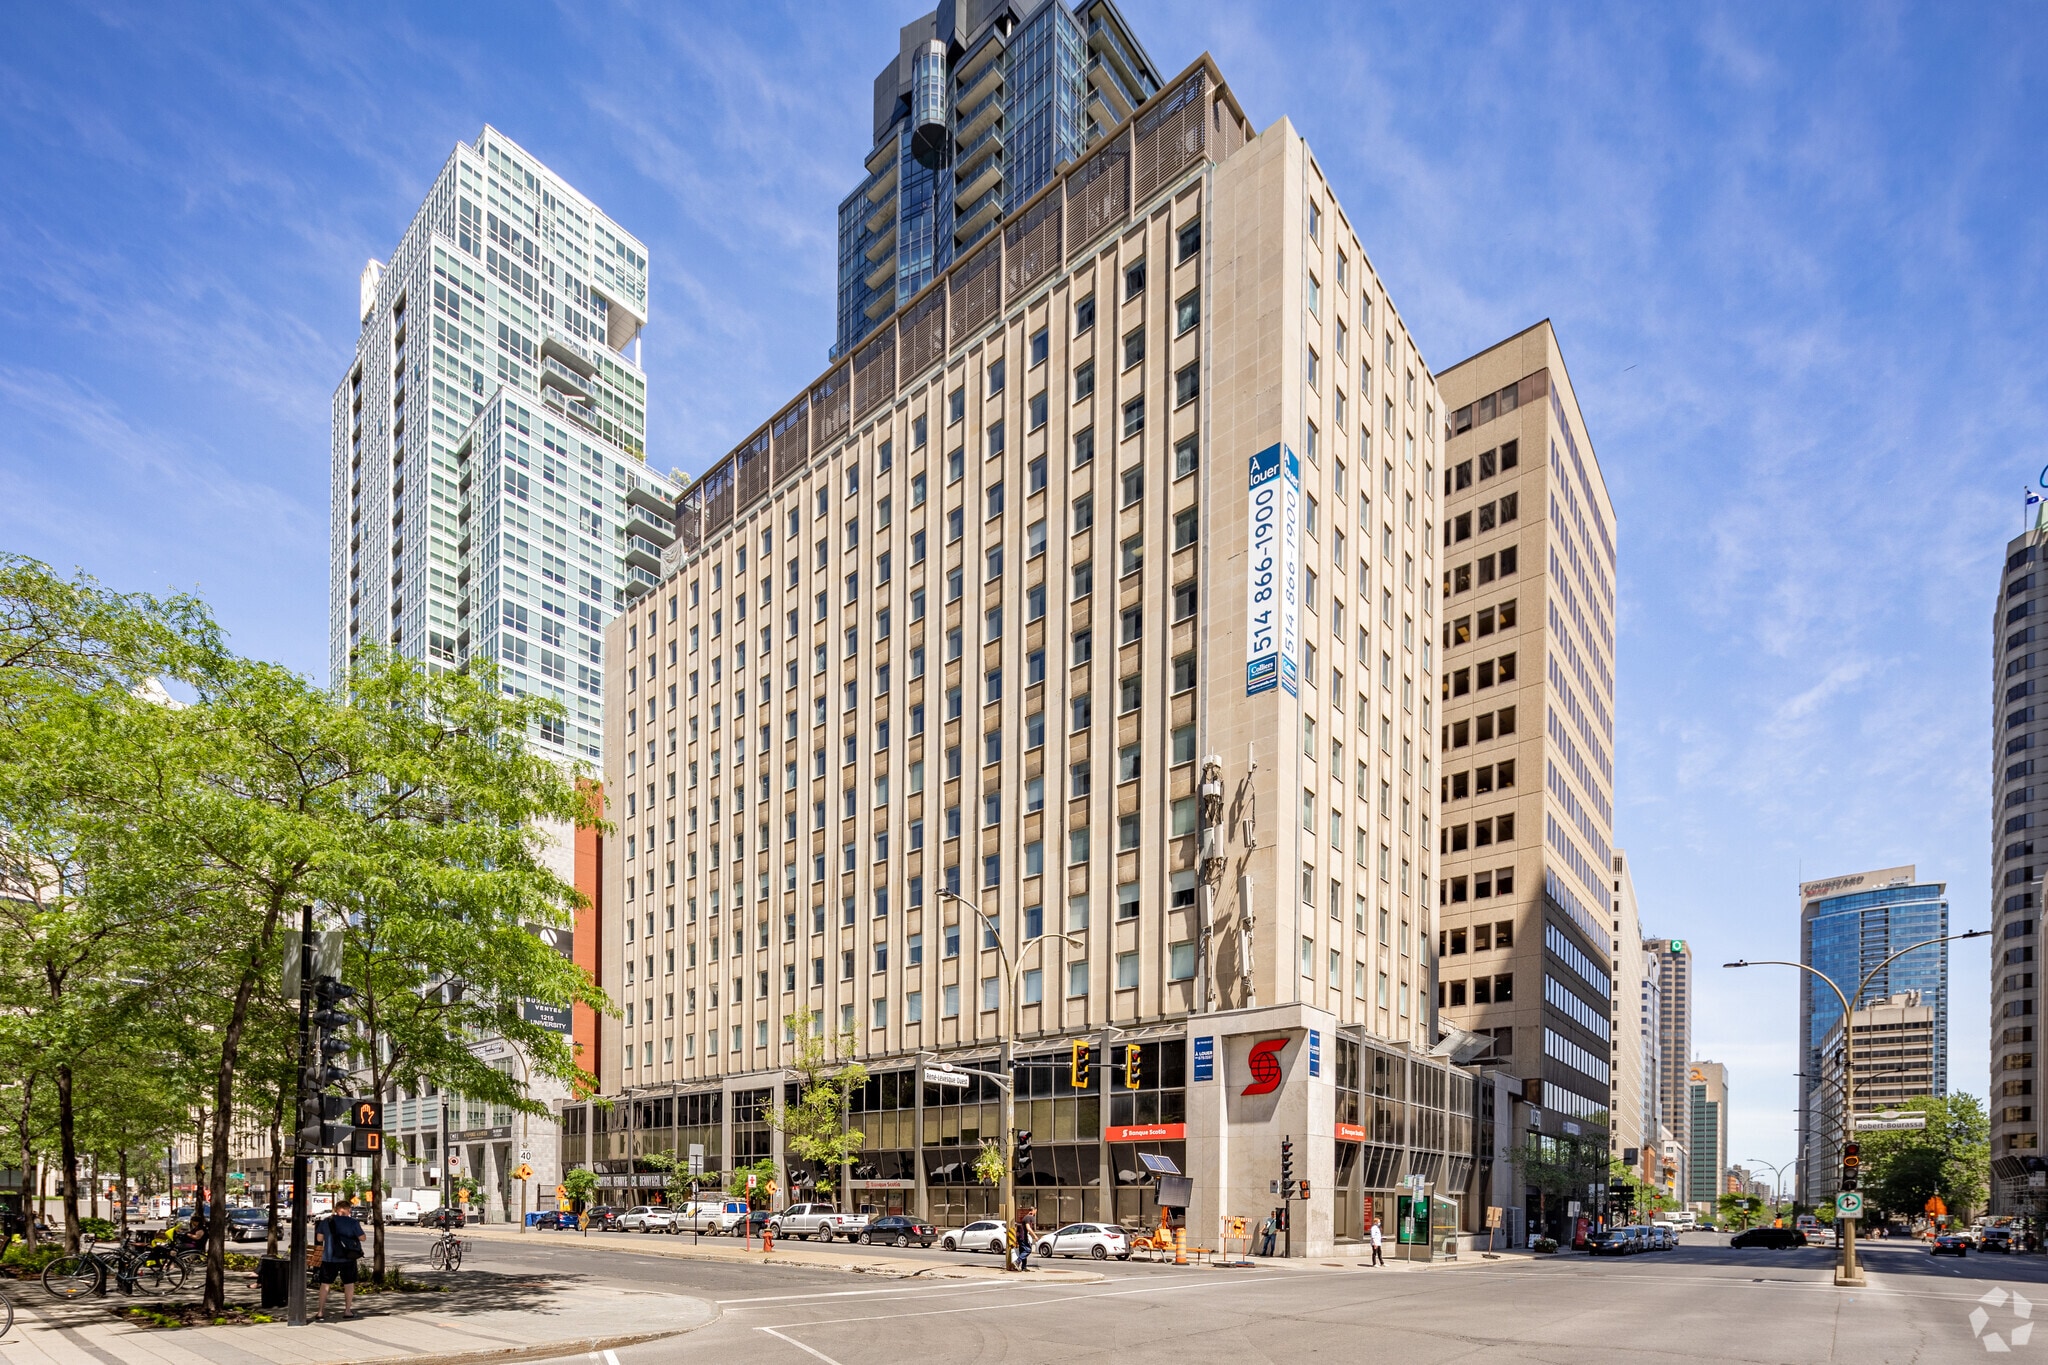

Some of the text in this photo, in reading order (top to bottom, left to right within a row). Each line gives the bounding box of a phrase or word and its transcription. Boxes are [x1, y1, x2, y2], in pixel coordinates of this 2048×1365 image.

[1250, 457, 1260, 473] À
[1250, 464, 1279, 486] louer
[1285, 491, 1296, 605] 866-1900
[1254, 489, 1273, 653] 514 866-1900
[1285, 613, 1295, 654] 514
[530, 1019, 567, 1029] UNIVERSITY
[1857, 1122, 1924, 1130] Robert-Bourassa
[520, 1151, 531, 1161] 40
